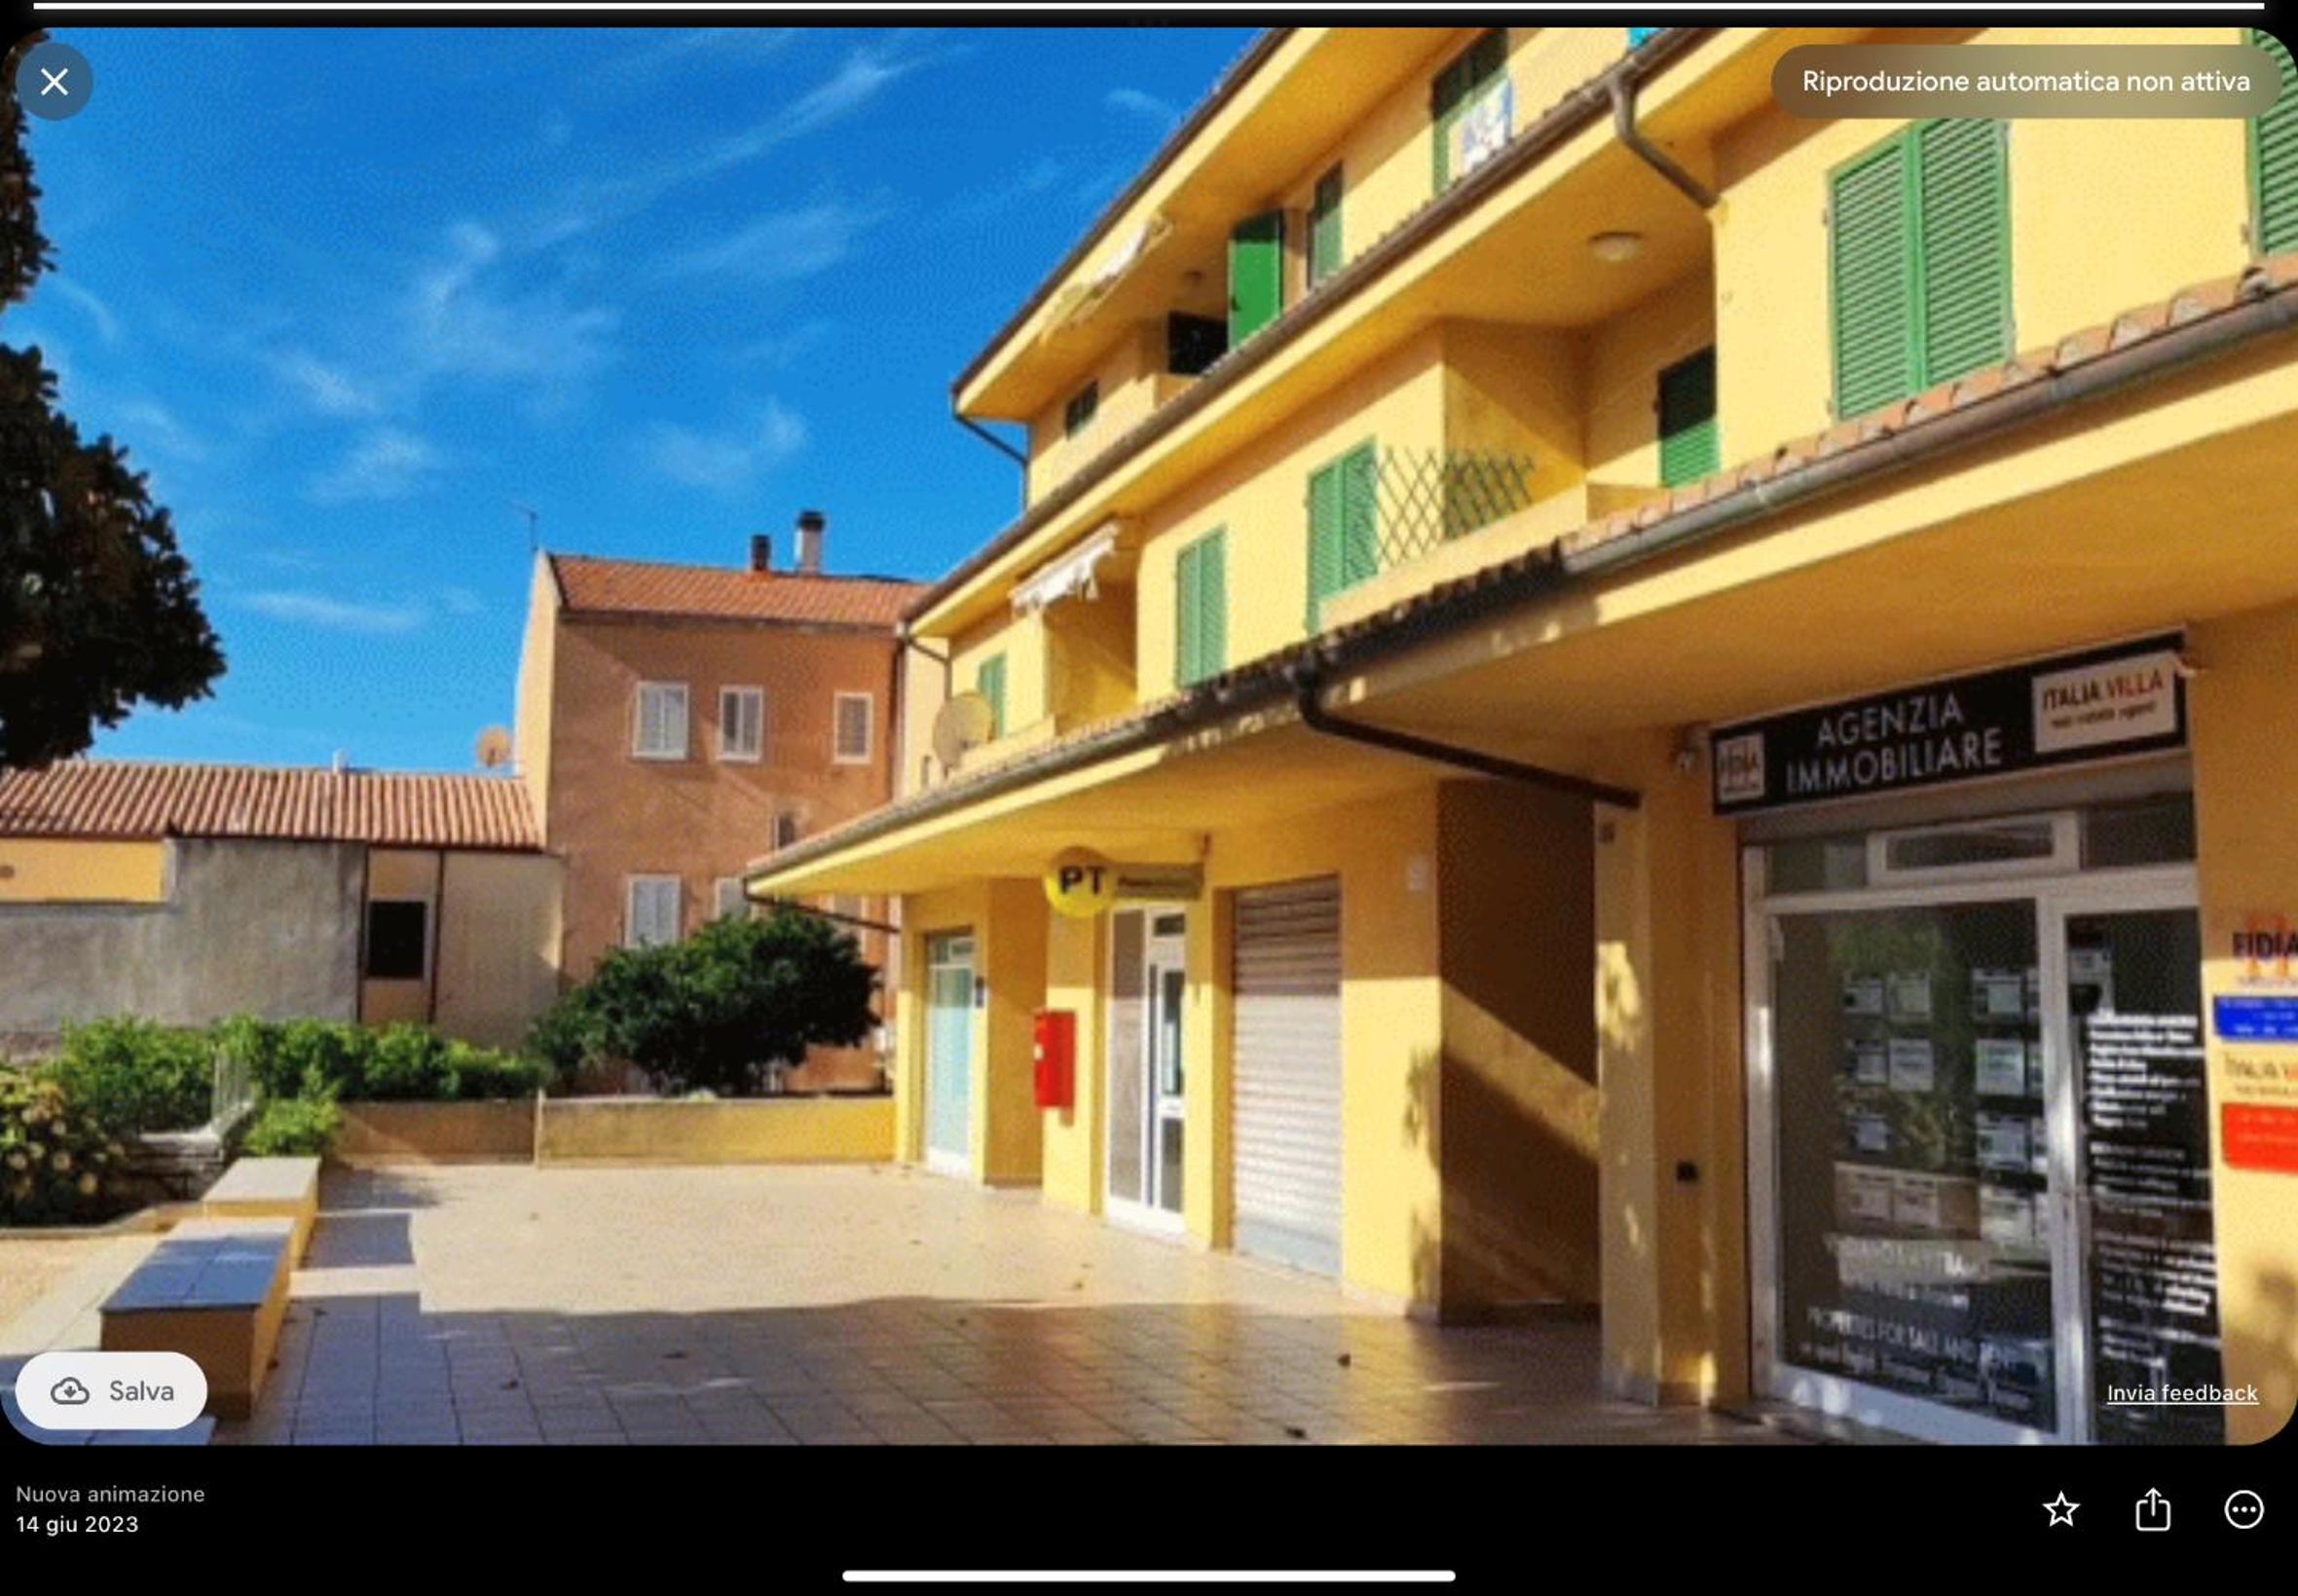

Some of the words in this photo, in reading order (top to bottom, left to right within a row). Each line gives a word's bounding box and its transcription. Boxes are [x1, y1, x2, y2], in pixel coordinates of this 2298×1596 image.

[2043, 679, 2100, 710] ITALIA
[2106, 669, 2164, 699] VILLA
[1817, 691, 1965, 749] AGENZIA
[1786, 727, 2003, 795] IMMOBILIARE
[1058, 865, 1107, 895] PT
